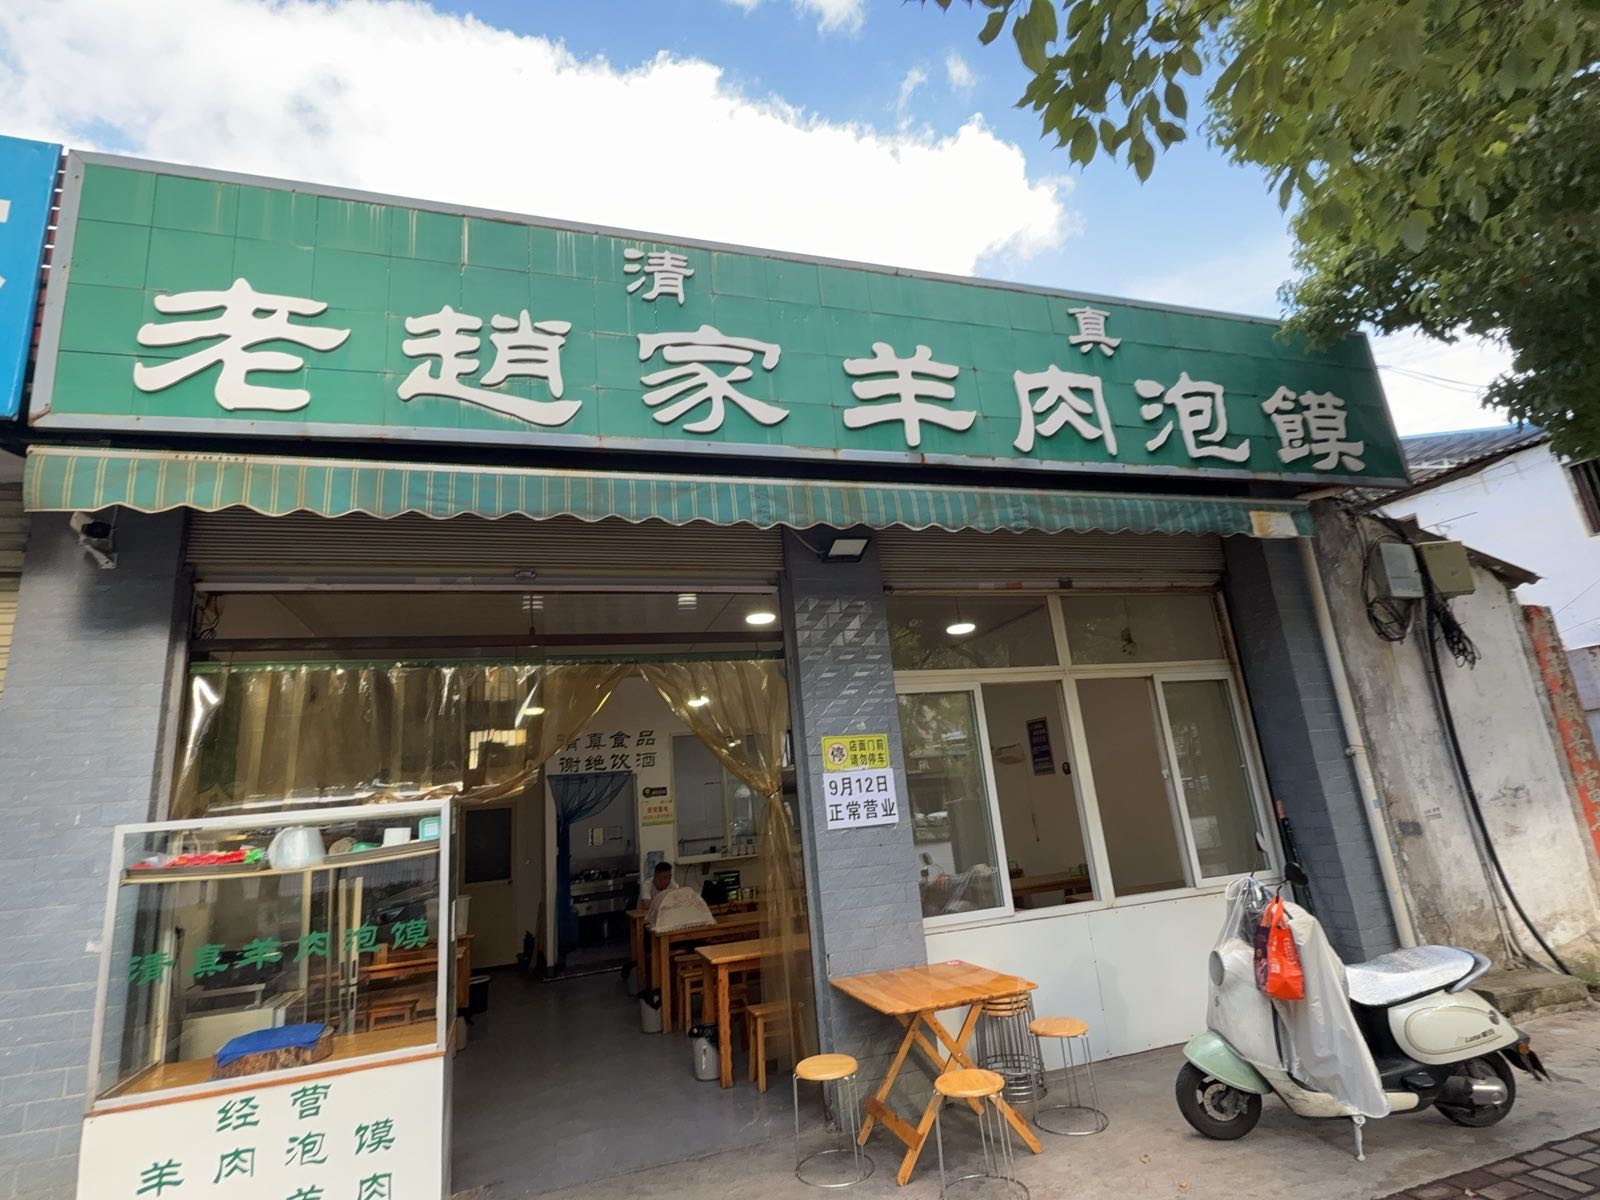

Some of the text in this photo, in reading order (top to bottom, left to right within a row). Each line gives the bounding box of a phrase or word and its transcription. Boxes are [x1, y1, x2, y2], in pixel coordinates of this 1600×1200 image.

[624, 247, 1122, 358] 清 真
[133, 277, 1366, 472] 老趙家羊肉泡饃
[559, 751, 657, 773] 谢绝饮酒
[850, 753, 885, 765] 请勿停车
[829, 775, 888, 797] 9月12日
[829, 798, 896, 821] 正常营业
[127, 918, 431, 988] 清真羊肉泡馍
[216, 1083, 333, 1133] 经营
[136, 1118, 396, 1198] 羊肉泡馍
